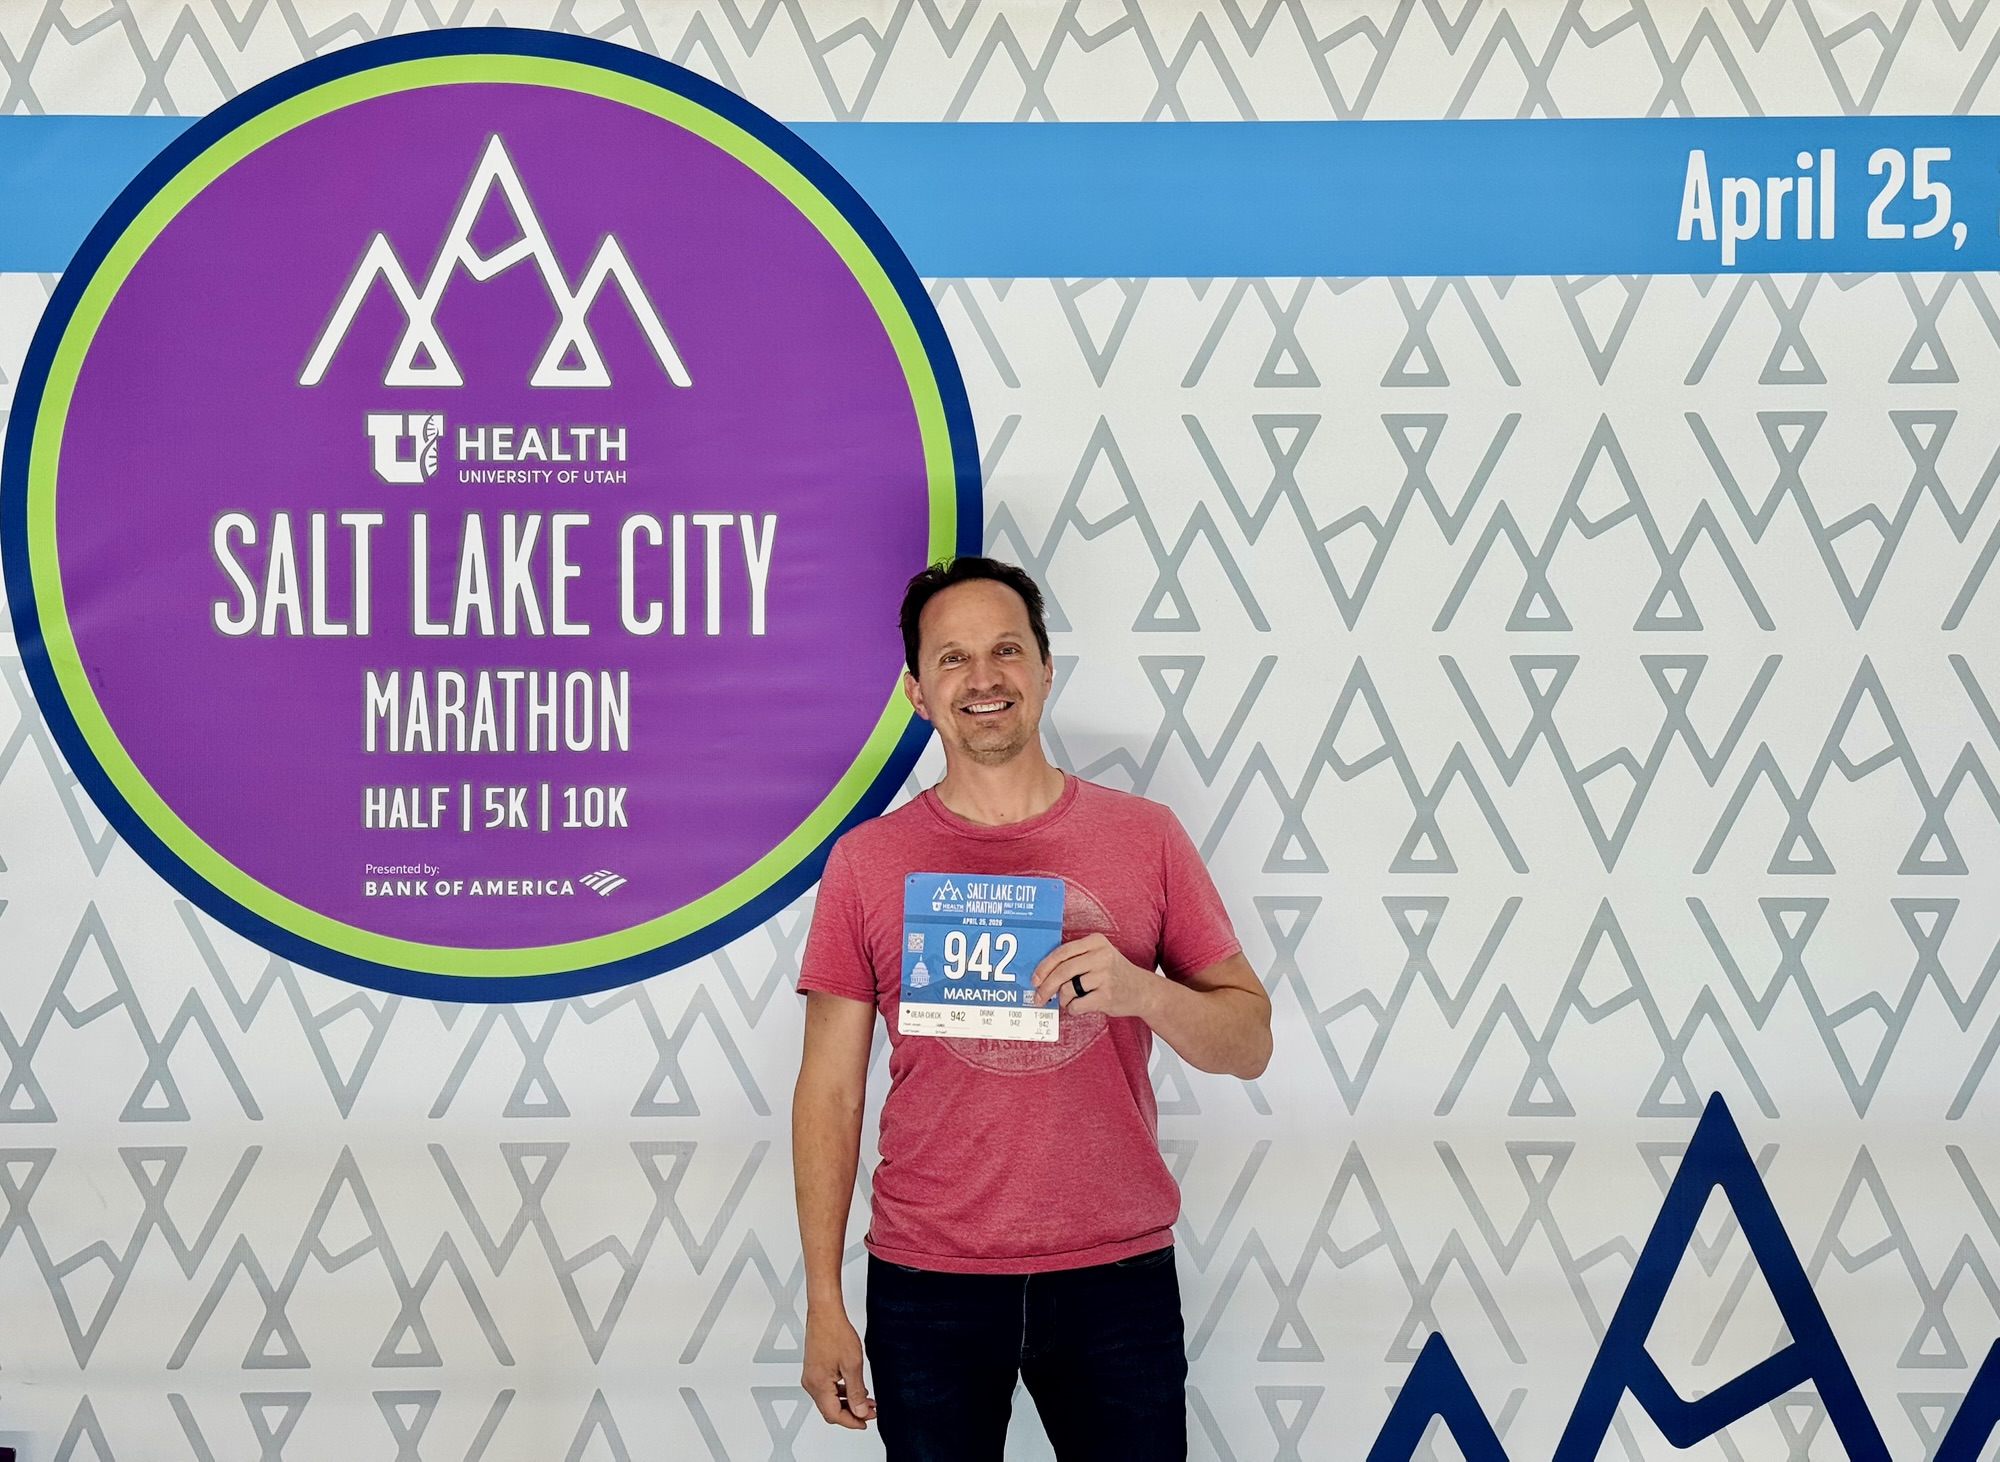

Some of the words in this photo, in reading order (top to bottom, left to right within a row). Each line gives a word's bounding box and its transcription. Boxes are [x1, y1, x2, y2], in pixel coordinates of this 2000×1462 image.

[1677, 148, 1835, 266] April
[1867, 147, 1968, 251] 25,
[458, 427, 627, 462] HEALTH
[459, 470, 553, 484] UNIVERSITY
[557, 470, 581, 484] OF
[584, 470, 627, 484] UTAH
[213, 512, 384, 637] SALT
[413, 512, 591, 637] LAKE
[620, 513, 778, 637] CITY
[365, 670, 630, 753] MARATHON
[364, 786, 450, 829] HALF
[485, 787, 528, 829] 5K
[562, 786, 629, 829] 10K
[365, 863, 420, 875] Presented
[422, 863, 440, 878] by:
[365, 880, 428, 897] BANK
[434, 879, 464, 897] OF
[469, 879, 575, 896] AMERICA
[967, 883, 987, 900] SALT
[991, 884, 1014, 902] LAKE
[1016, 885, 1037, 902] CITY
[966, 900, 1003, 915] MARATHON
[963, 917, 978, 925] APRIL
[979, 918, 988, 926] 25,
[943, 930, 1018, 983] 942
[943, 987, 1017, 1002] MARATHON
[925, 1011, 942, 1019] CHECK
[950, 1010, 966, 1022] 942
[980, 1009, 994, 1017] DRINK
[1034, 1012, 1054, 1020] T-SHIRT
[982, 1018, 992, 1026] 942
[1039, 1020, 1049, 1028] 942
